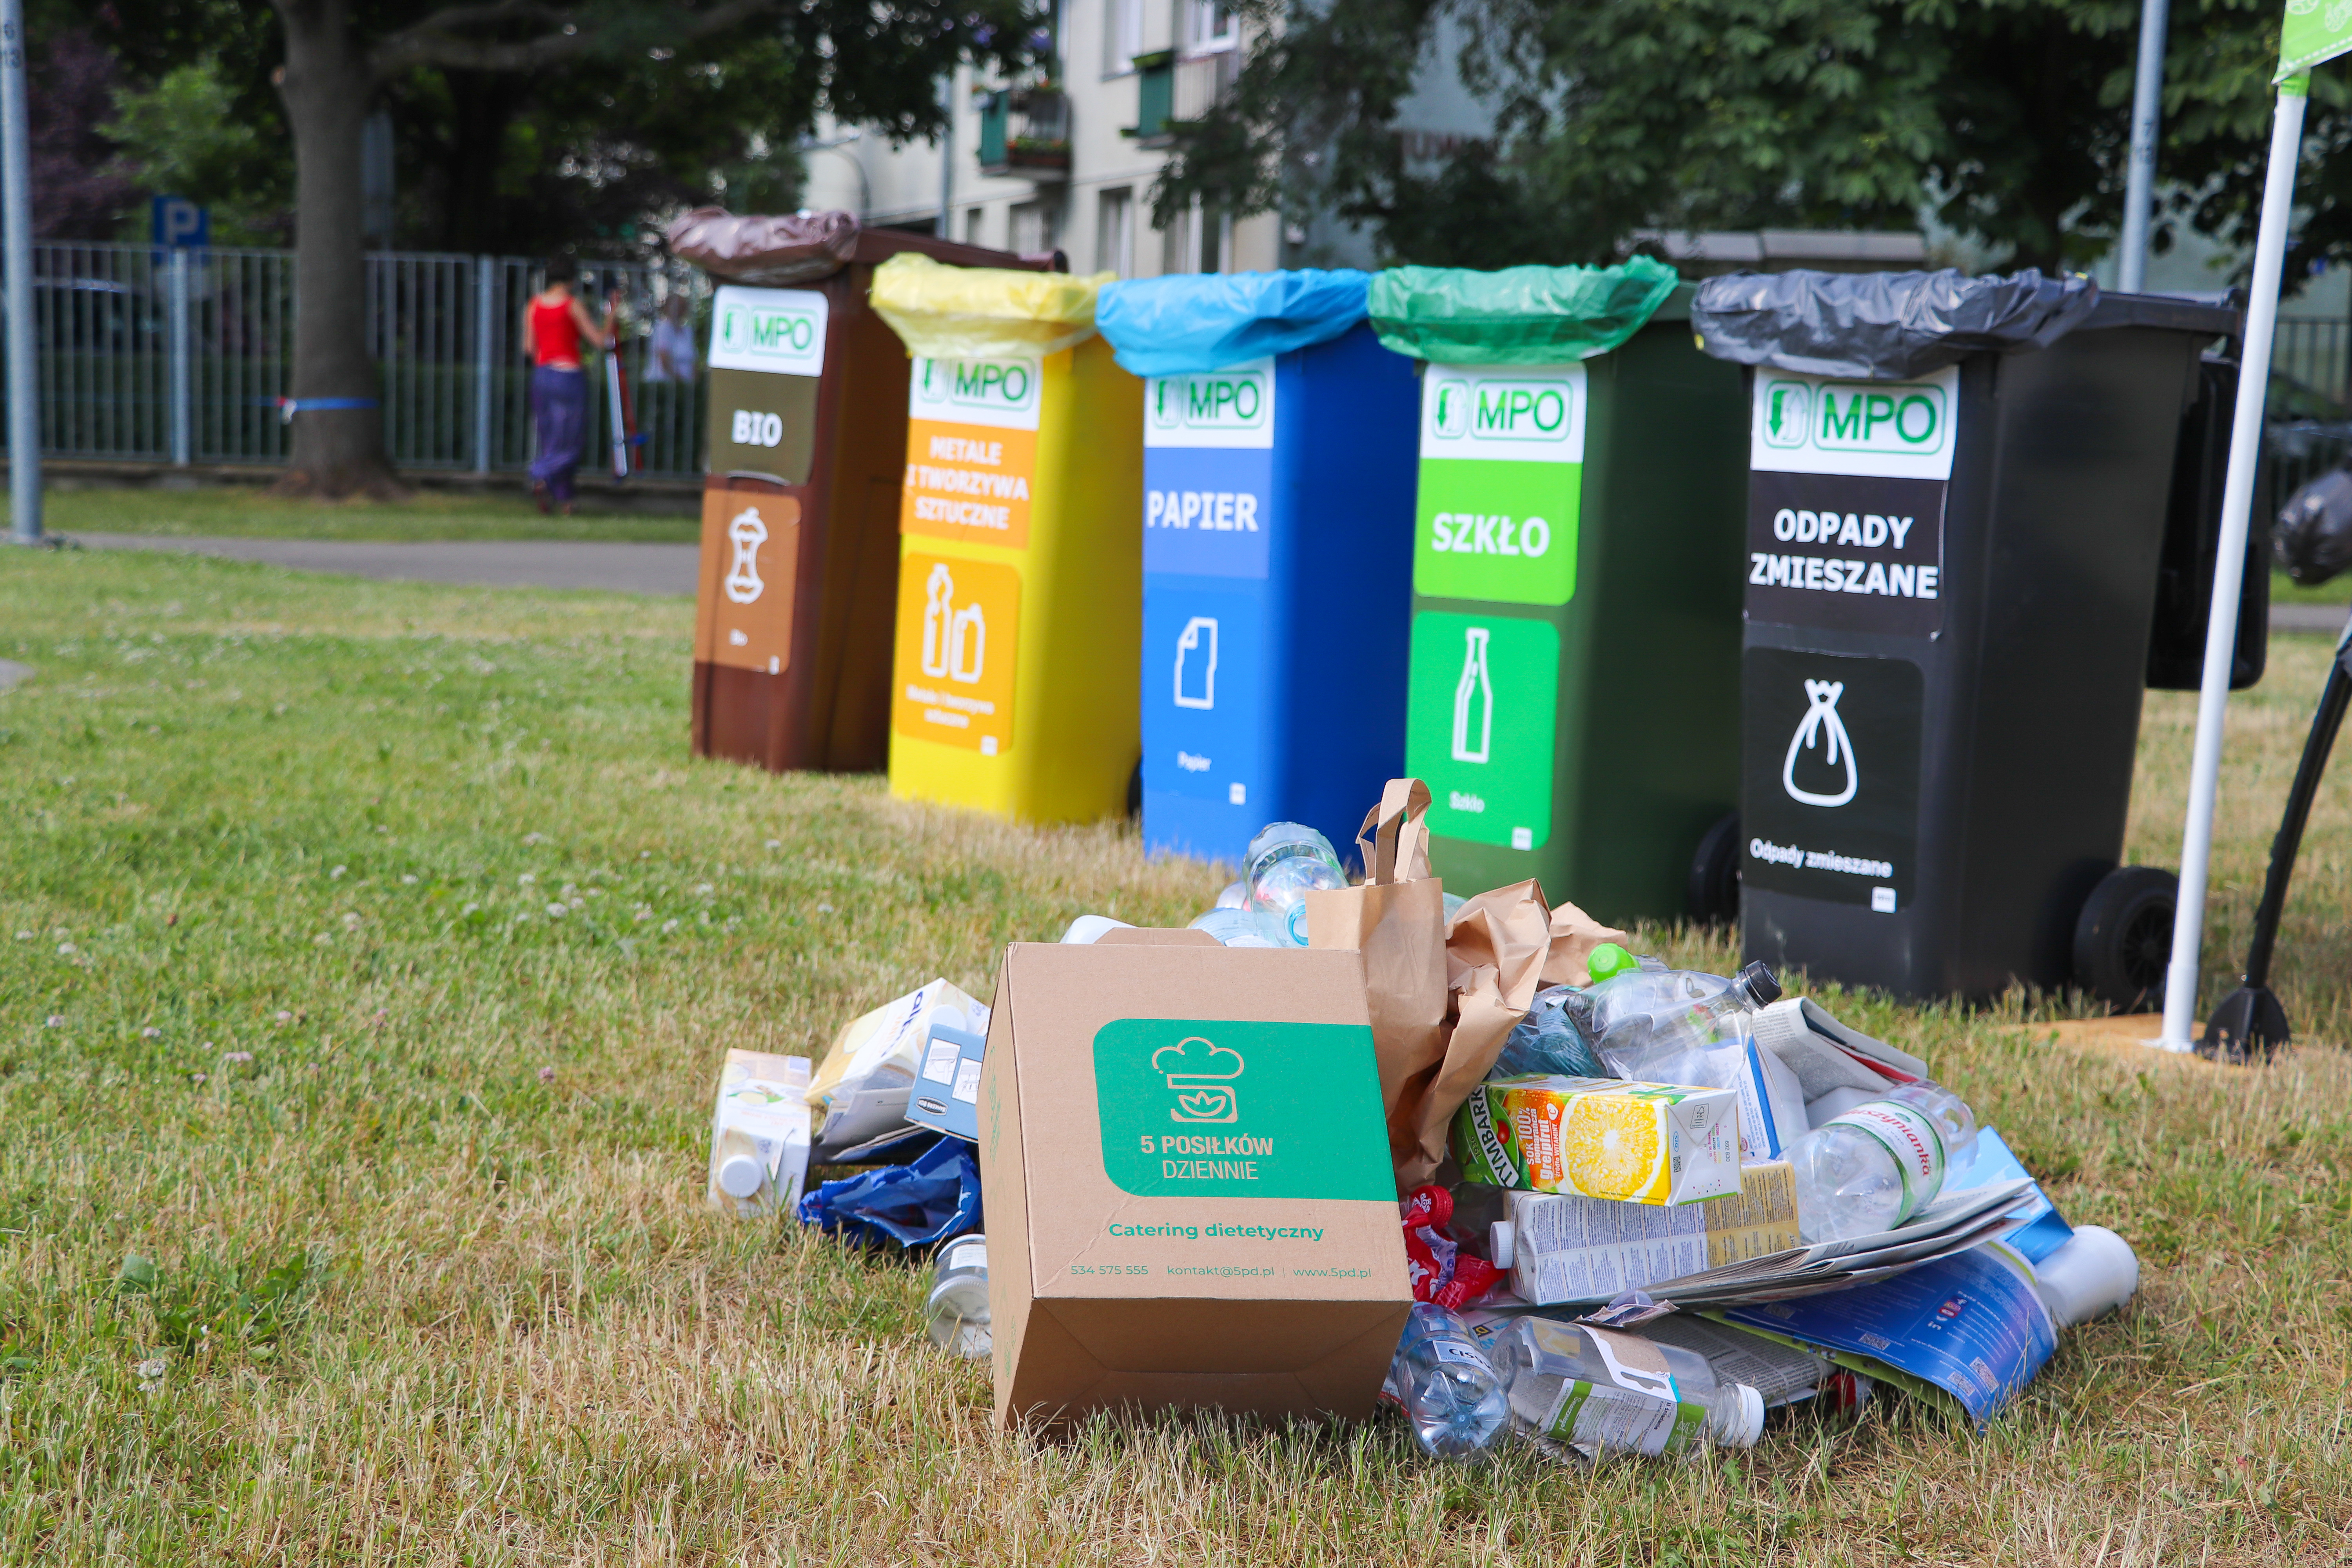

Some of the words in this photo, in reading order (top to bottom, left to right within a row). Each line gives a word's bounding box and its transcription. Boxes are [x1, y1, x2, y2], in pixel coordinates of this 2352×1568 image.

[164, 198, 199, 243] P
[754, 316, 812, 350] MPO
[957, 365, 1027, 401] MPO
[1189, 380, 1259, 419] MPO
[731, 410, 783, 448] BIO
[1477, 390, 1564, 432] MPO
[1822, 393, 1936, 444] MPO
[930, 436, 1002, 465] METALE
[918, 468, 1029, 501] TWORZYWA
[915, 496, 1009, 530] SZTUCZNE
[1147, 491, 1258, 532] PAPIER
[1773, 508, 1913, 549] ODPADY
[1432, 512, 1550, 557] SZKŁO
[1749, 552, 1938, 599] ZMIESZANE
[1177, 750, 1212, 772] Papier
[1449, 791, 1485, 813] Szkło
[1749, 837, 1805, 869] Odpady
[1805, 850, 1893, 878] zmieszane
[1471, 1087, 1512, 1187] TYMBARK
[1517, 1107, 1533, 1141] 100%
[1530, 1108, 1541, 1164] pomarańcza
[1141, 1135, 1154, 1153] 5
[1161, 1133, 1273, 1156] POSIŁKÓW
[1526, 1142, 1535, 1165] SOK
[1162, 1160, 1259, 1180] DZIENNIE
[1109, 1223, 1199, 1240] Catering
[1204, 1223, 1324, 1242] dietetyczny
[1071, 1265, 1095, 1275] 534
[1100, 1265, 1122, 1275] 575
[1126, 1265, 1148, 1275] 555
[1167, 1265, 1275, 1278] kontakt@5pd.pl
[1292, 1268, 1372, 1279] www.5pd.pl
